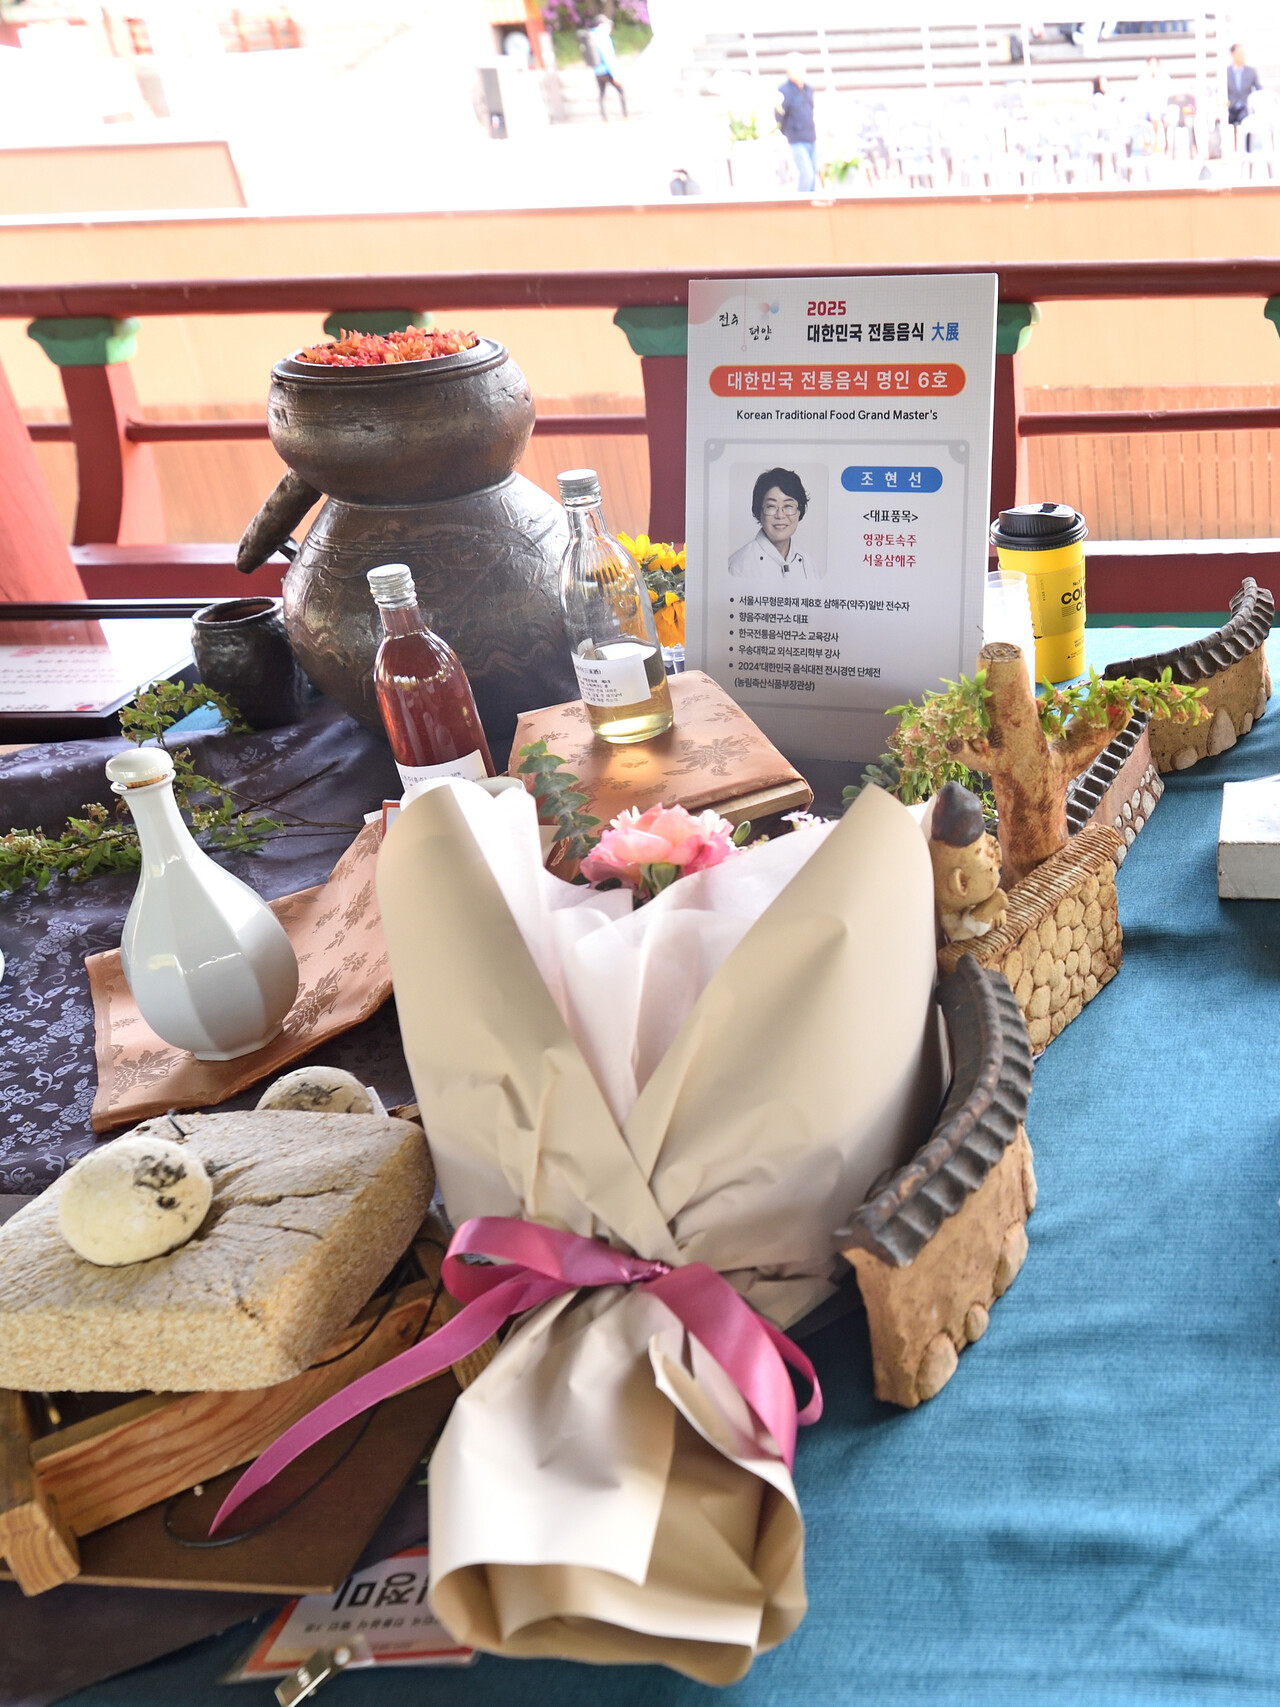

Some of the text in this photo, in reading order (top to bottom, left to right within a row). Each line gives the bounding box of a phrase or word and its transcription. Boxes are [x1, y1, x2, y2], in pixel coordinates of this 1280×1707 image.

[807, 301, 847, 316] 2025
[718, 313, 739, 327] 전주
[749, 325, 772, 342] 평양
[807, 322, 959, 343] 대한민국 전통음식 大展
[727, 370, 948, 391] 대한민국 전통음식 명인 6호
[736, 409, 938, 421] Korean Traditional Food Grand Master's
[863, 510, 919, 524] <대표품목>
[863, 533, 917, 548] 영광토속주
[863, 554, 917, 568] 서울삼해주
[739, 596, 800, 608] 서울시무형문화재
[800, 598, 822, 608] 제8호
[885, 601, 910, 612] 전수자
[793, 614, 809, 625] 대표
[739, 628, 839, 643] 한국전통음식연구소 교육강사
[738, 645, 840, 659] 우송대학교 외식조리학부 강사
[793, 664, 824, 676] 음식대전
[825, 665, 856, 677] 전시경연
[857, 667, 881, 679] 단체전
[332, 1573, 430, 1612] 정미
